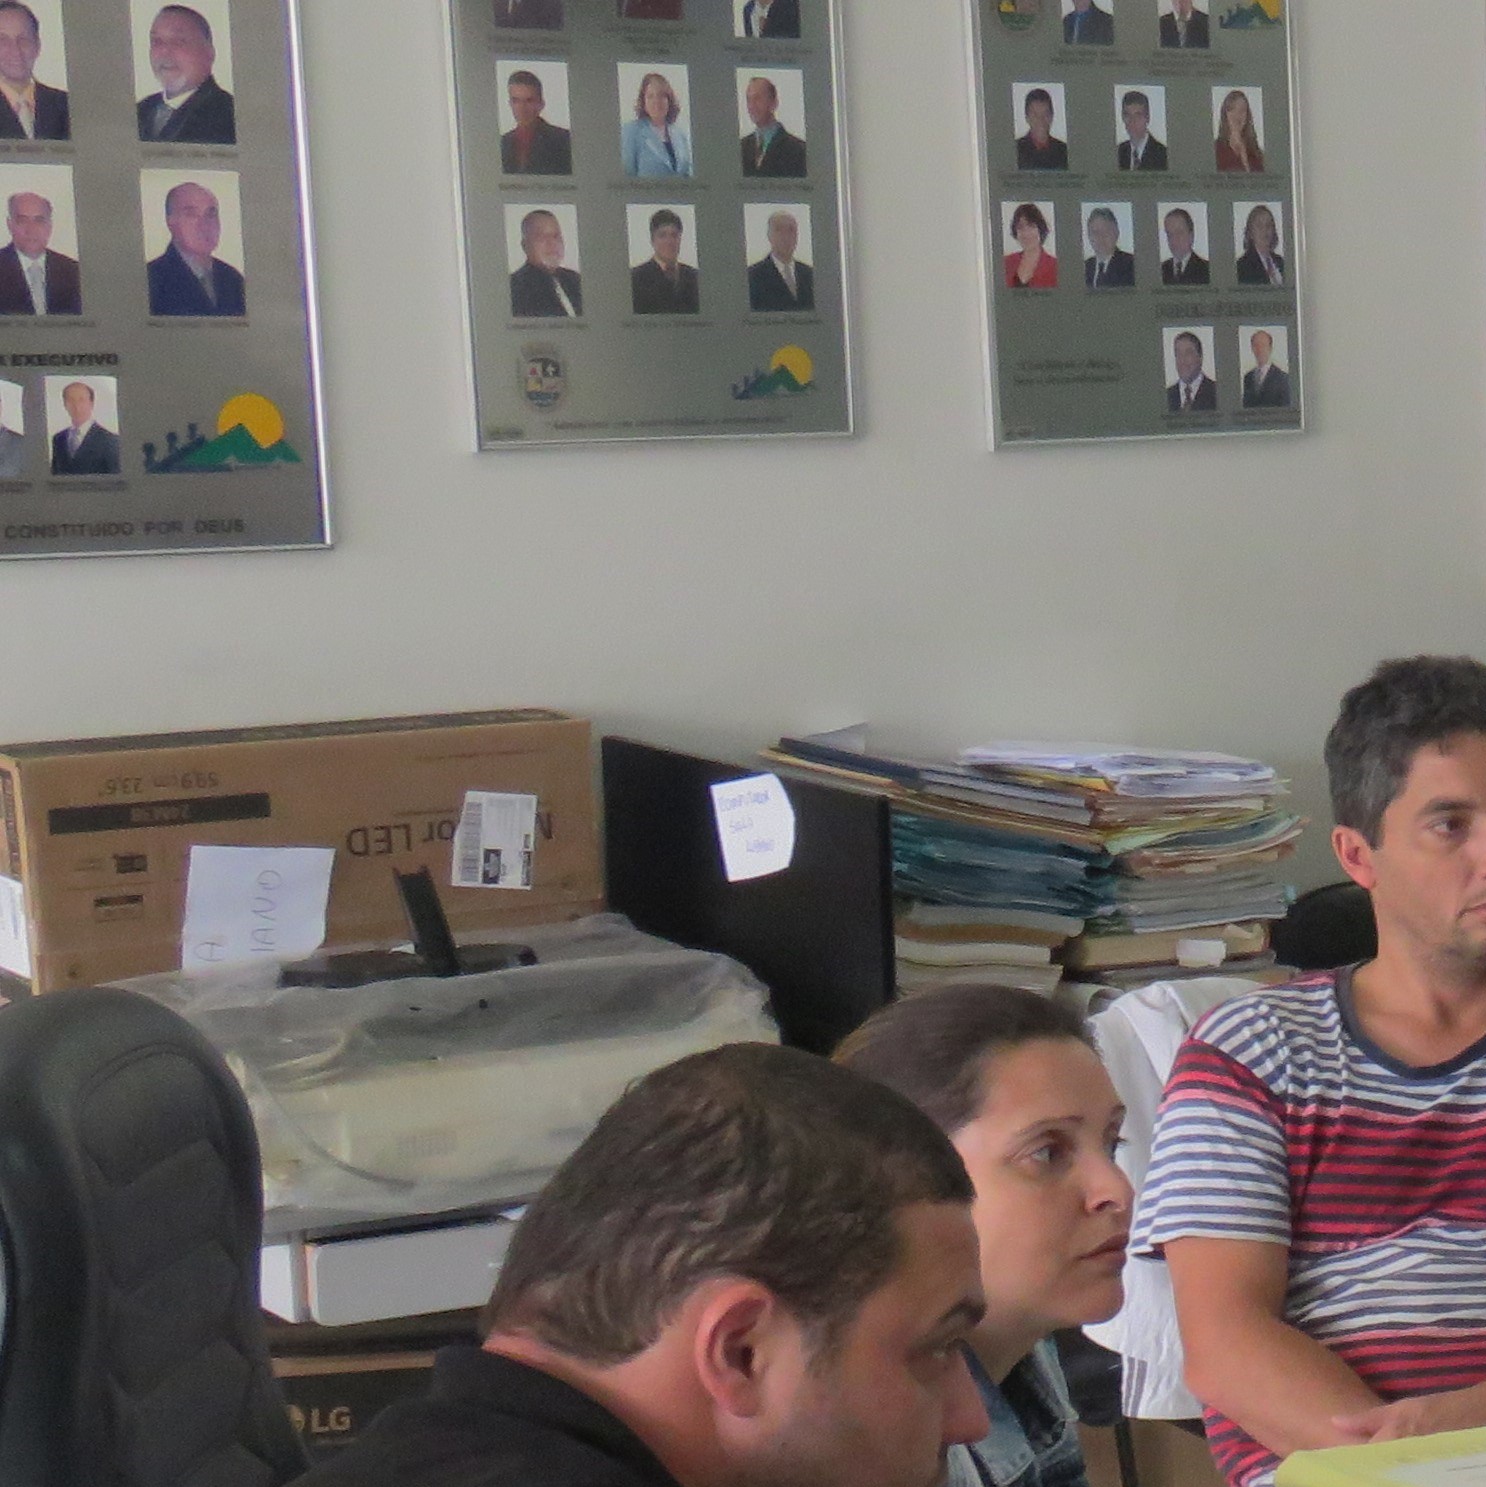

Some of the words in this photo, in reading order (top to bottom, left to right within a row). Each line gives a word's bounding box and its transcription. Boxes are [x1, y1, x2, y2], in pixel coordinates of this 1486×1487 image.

[11, 352, 119, 367] EXECUTIVO
[143, 519, 183, 536] POR
[194, 518, 244, 534] DEUS
[346, 823, 412, 857] LED
[310, 1407, 352, 1433] LG
